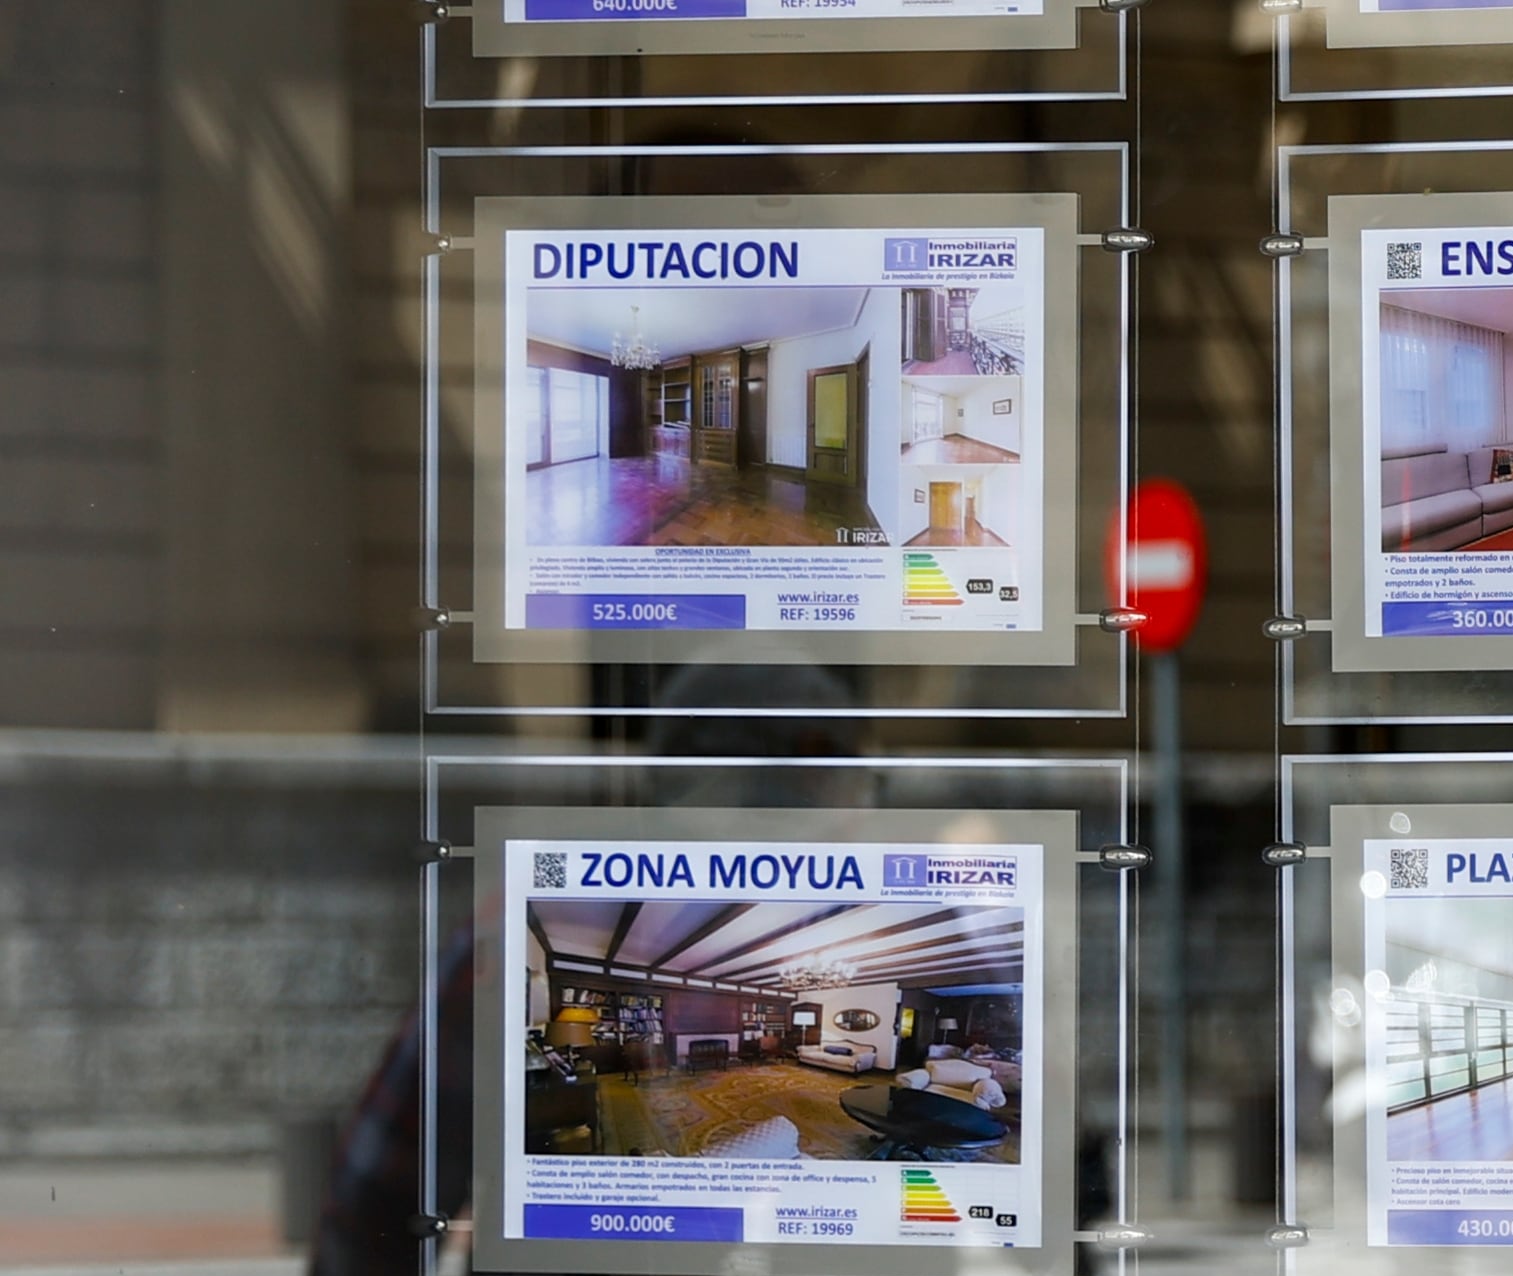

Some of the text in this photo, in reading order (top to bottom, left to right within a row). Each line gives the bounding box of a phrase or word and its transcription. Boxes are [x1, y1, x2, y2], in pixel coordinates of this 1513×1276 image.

[929, 241, 1015, 251] Inmobiliaria
[533, 242, 798, 279] DIPUTACION
[929, 253, 1014, 267] IRIZAR
[778, 591, 859, 603] www.irizar.es
[593, 603, 677, 621] 525.000€
[780, 608, 855, 621] REF: 19596
[928, 858, 1015, 869] Inmobiliaria
[581, 853, 864, 889] ZONA MOYUA
[927, 871, 1013, 885] IRIZAR
[776, 1206, 857, 1218] www.irizar.es
[971, 1207, 990, 1217] 218
[590, 1214, 675, 1232] 900.000€
[778, 1222, 853, 1236] REF: 19969
